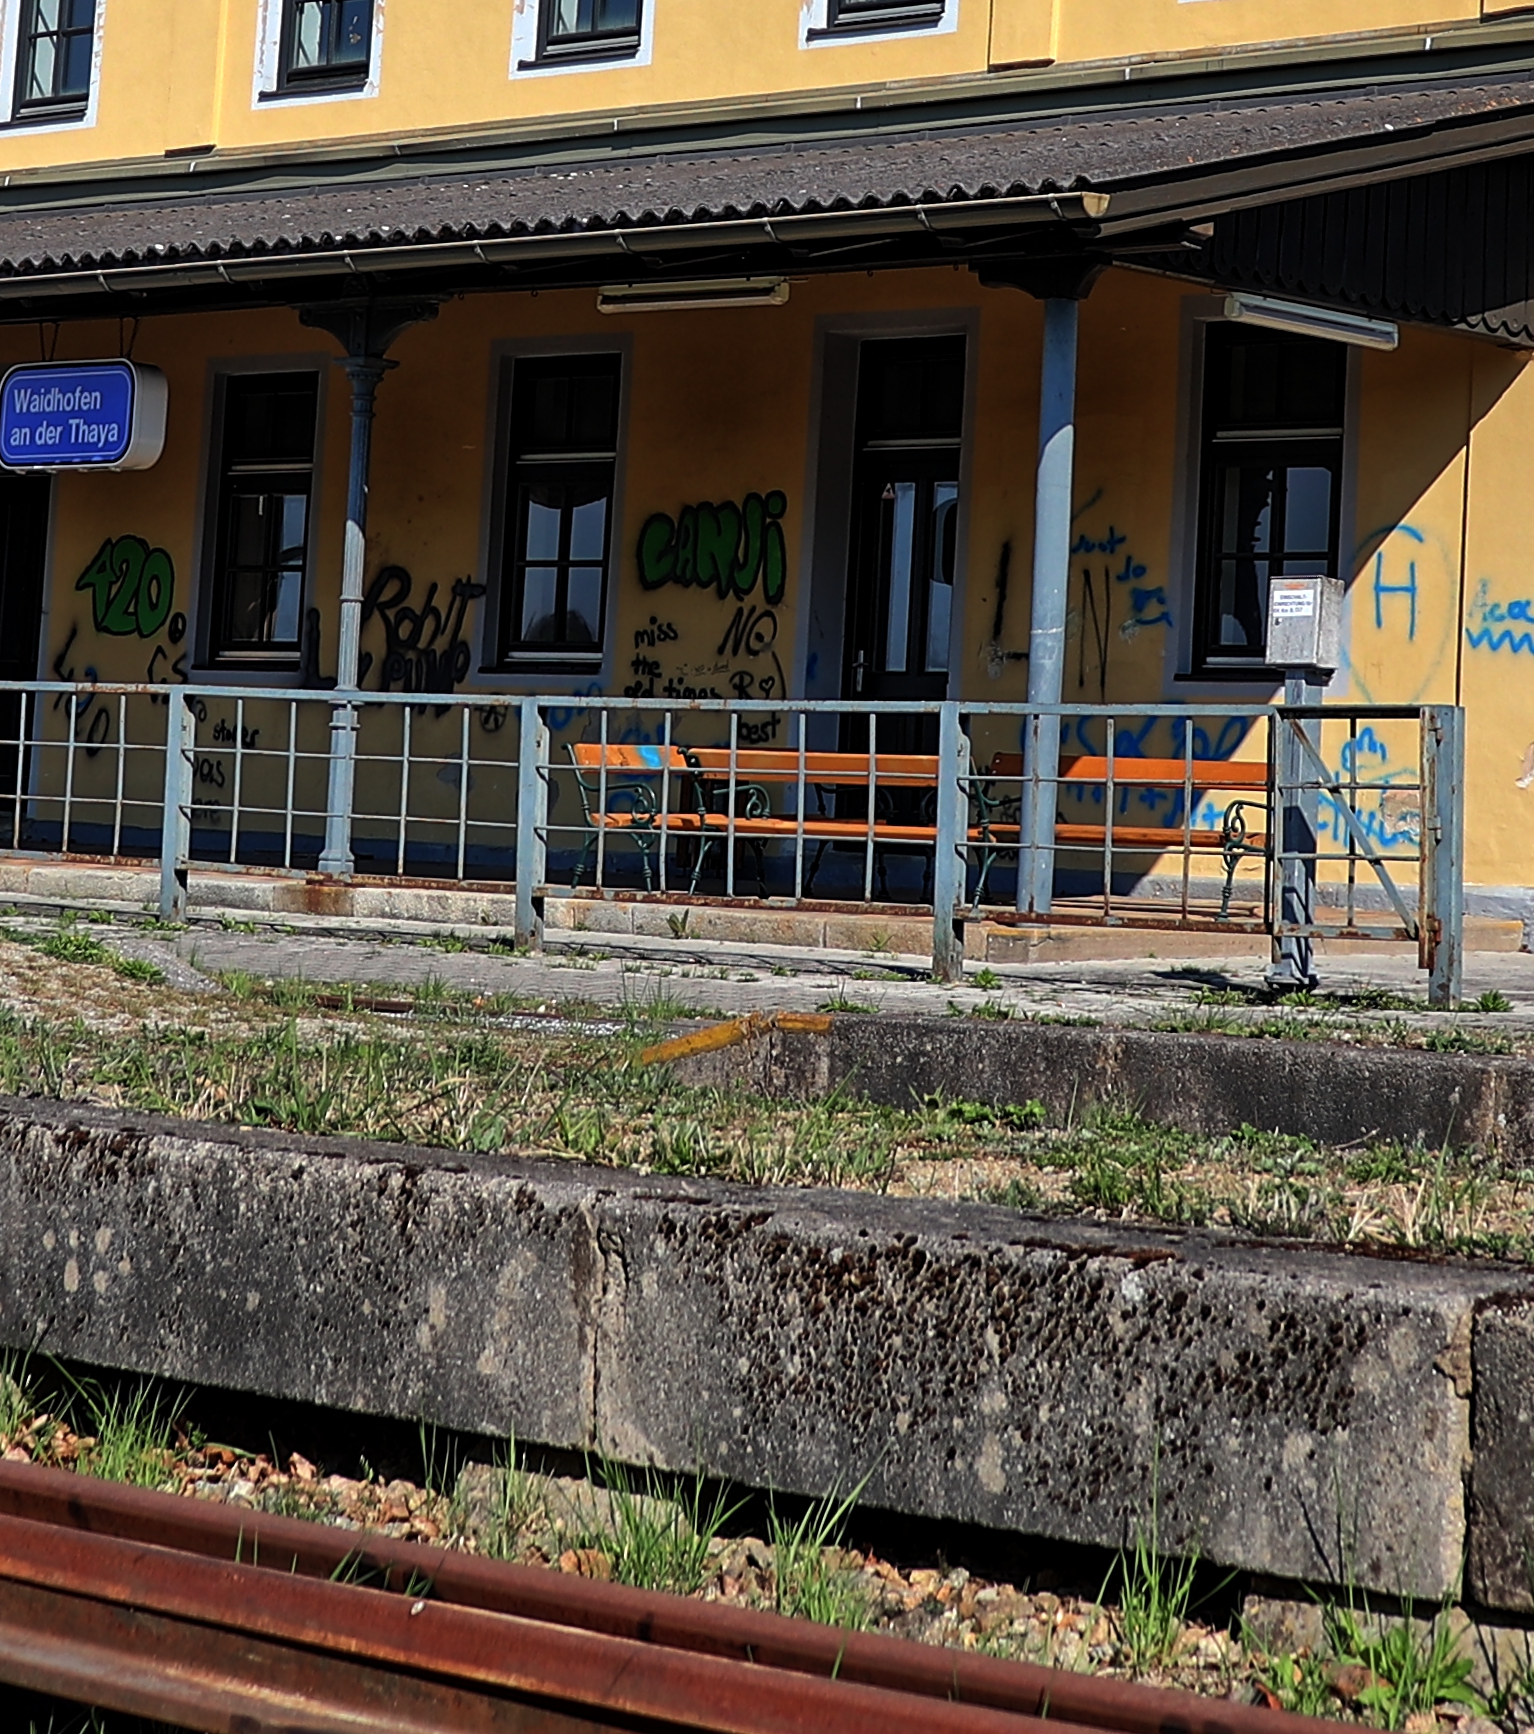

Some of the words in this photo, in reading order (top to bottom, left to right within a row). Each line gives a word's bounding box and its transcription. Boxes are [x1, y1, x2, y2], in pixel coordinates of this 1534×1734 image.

[13, 386, 101, 414] Waidhofen
[9, 426, 31, 446] an
[35, 420, 64, 446] der
[68, 418, 119, 448] Thaya
[631, 653, 662, 679] the
